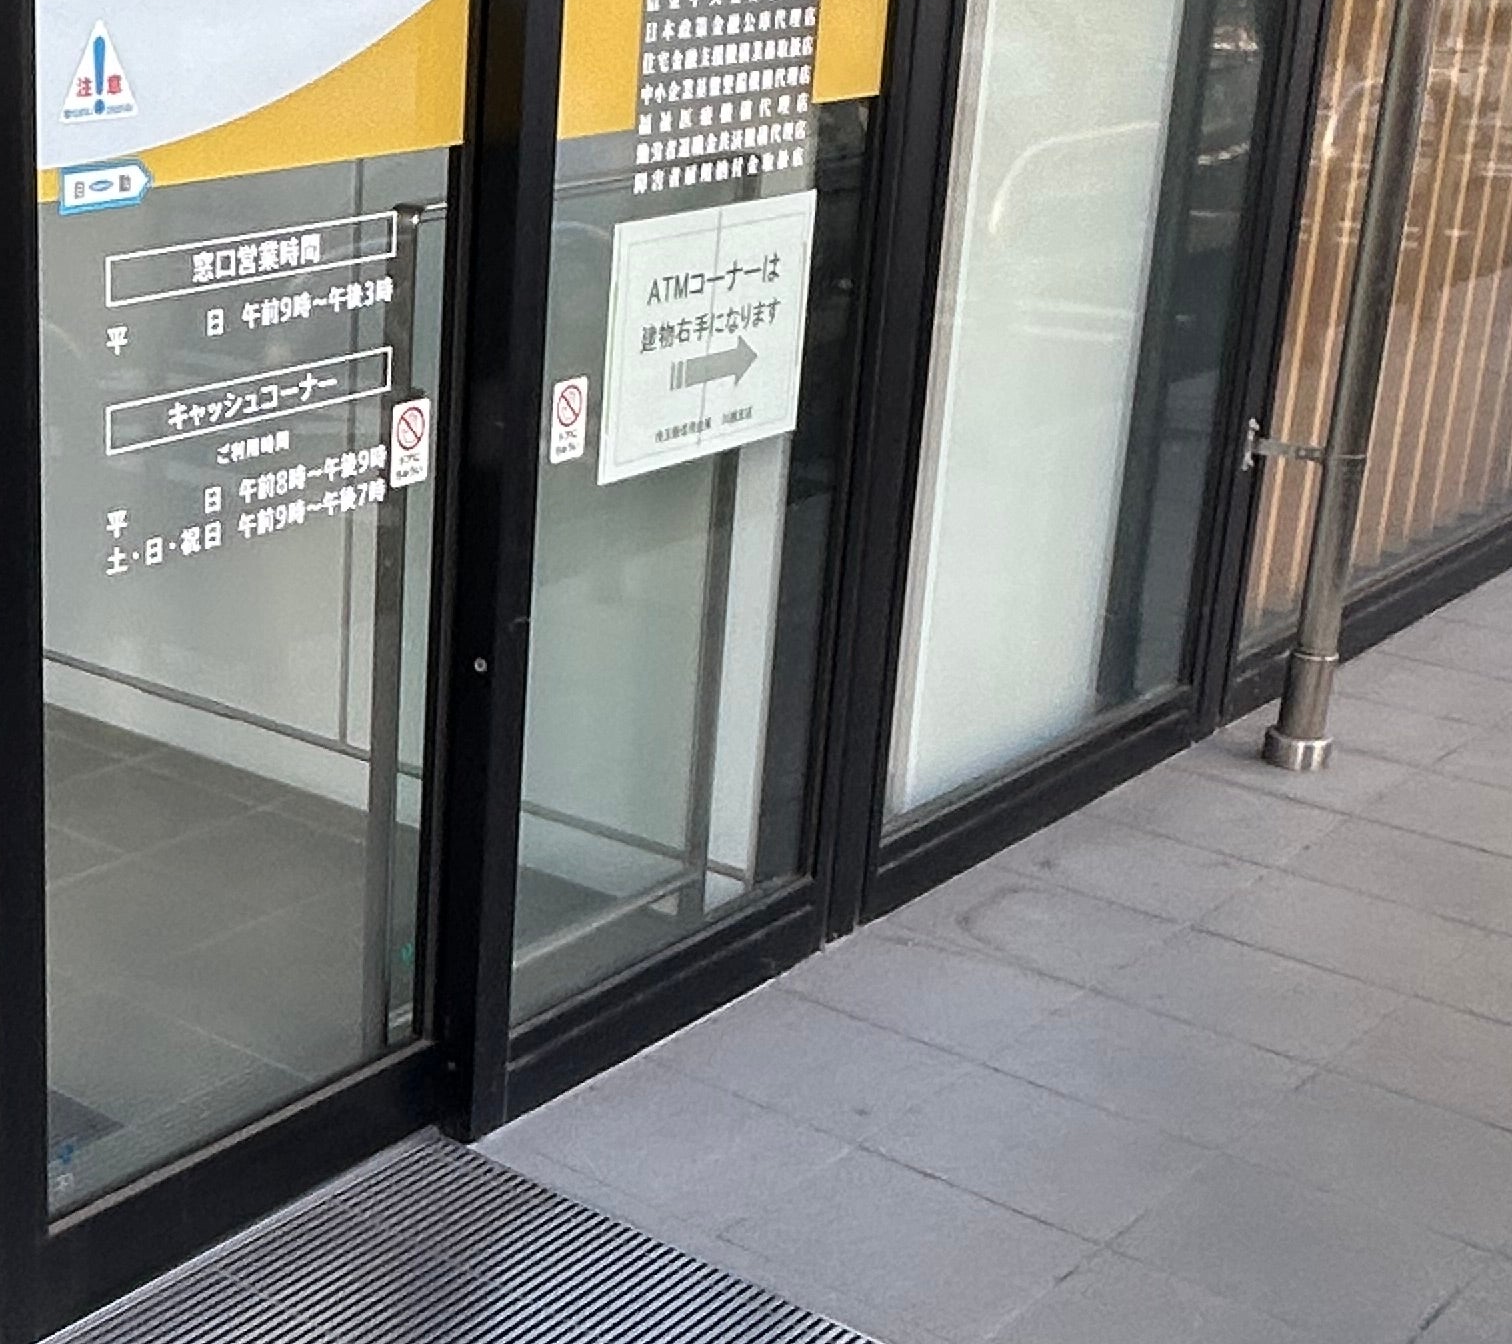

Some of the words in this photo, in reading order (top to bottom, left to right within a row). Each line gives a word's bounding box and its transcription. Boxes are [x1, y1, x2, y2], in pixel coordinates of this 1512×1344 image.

[192, 233, 321, 284] 窓口営業時間
[646, 252, 781, 306] ATMコーナーは
[640, 297, 782, 354] 建物右手になります
[167, 372, 338, 431] キャッシュコーナー
